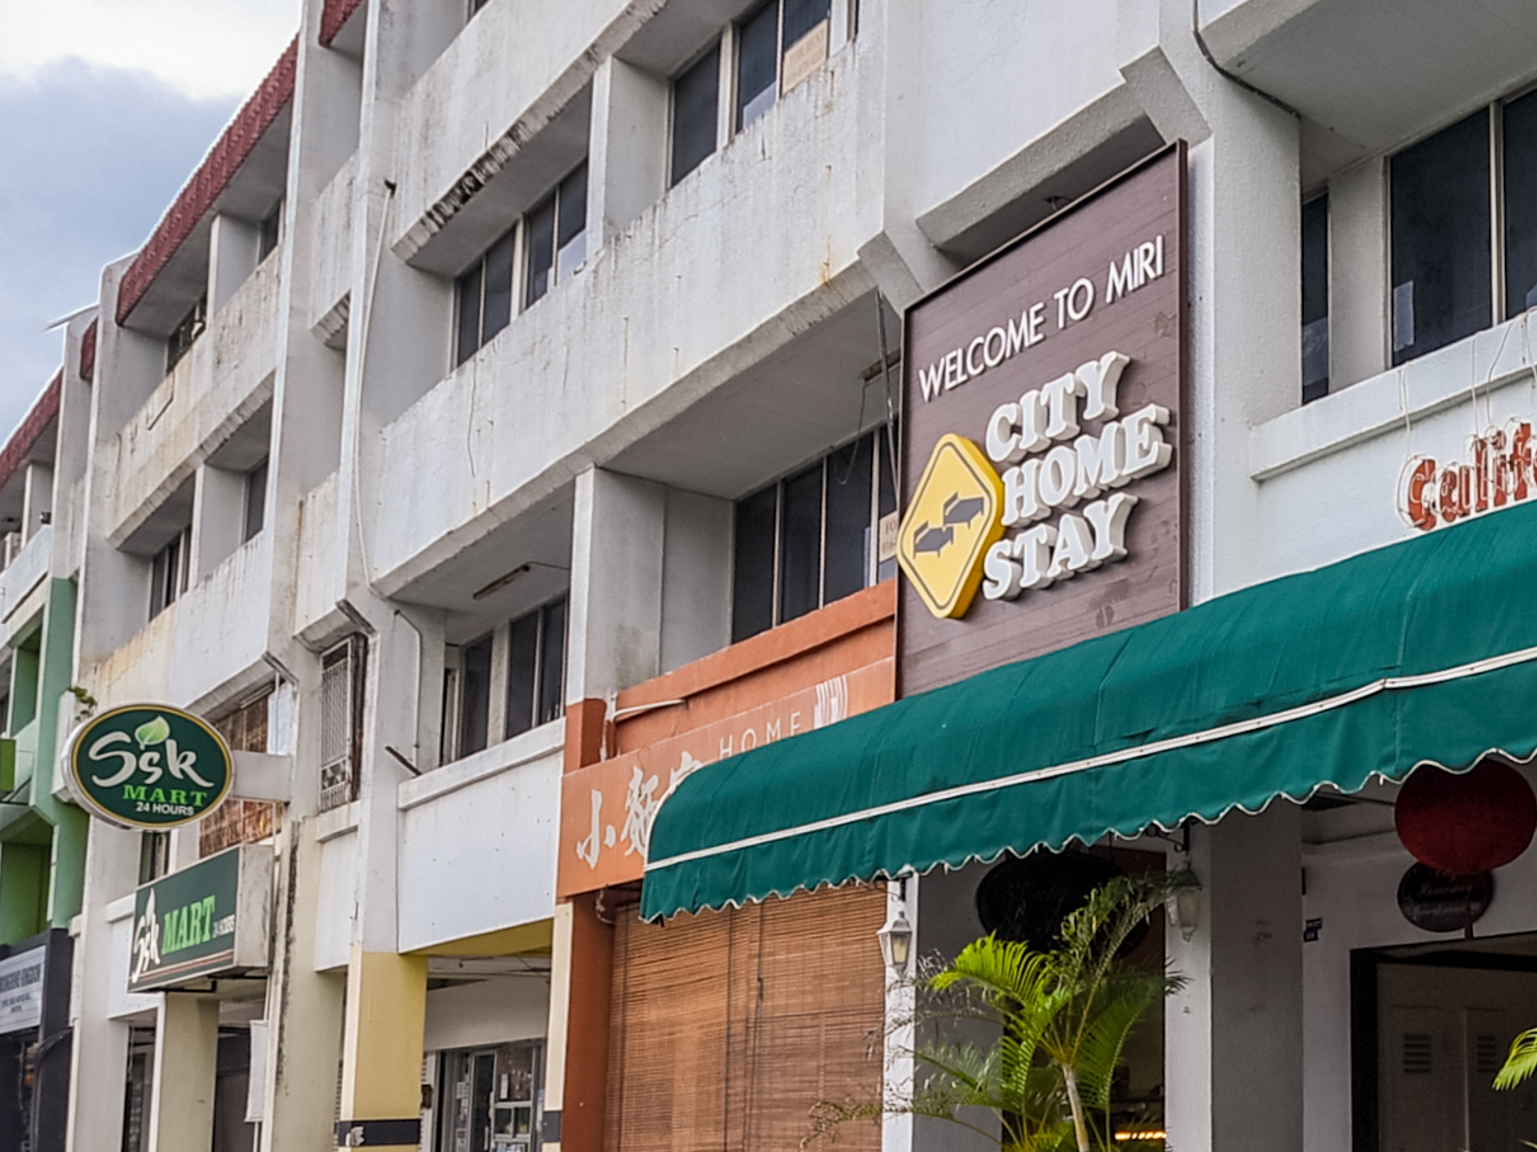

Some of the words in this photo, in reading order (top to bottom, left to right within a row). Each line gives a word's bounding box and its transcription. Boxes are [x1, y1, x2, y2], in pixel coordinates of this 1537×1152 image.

[918, 301, 1045, 403] WELCOME
[1054, 278, 1095, 329] TO
[1105, 234, 1164, 304] MIRI
[986, 351, 1130, 462] CITY
[1001, 403, 1172, 526] HOME
[982, 492, 1139, 599] STAY
[123, 784, 207, 807] MART
[136, 801, 150, 813] 24
[152, 804, 194, 816] HOURS
[161, 894, 216, 955] MART
